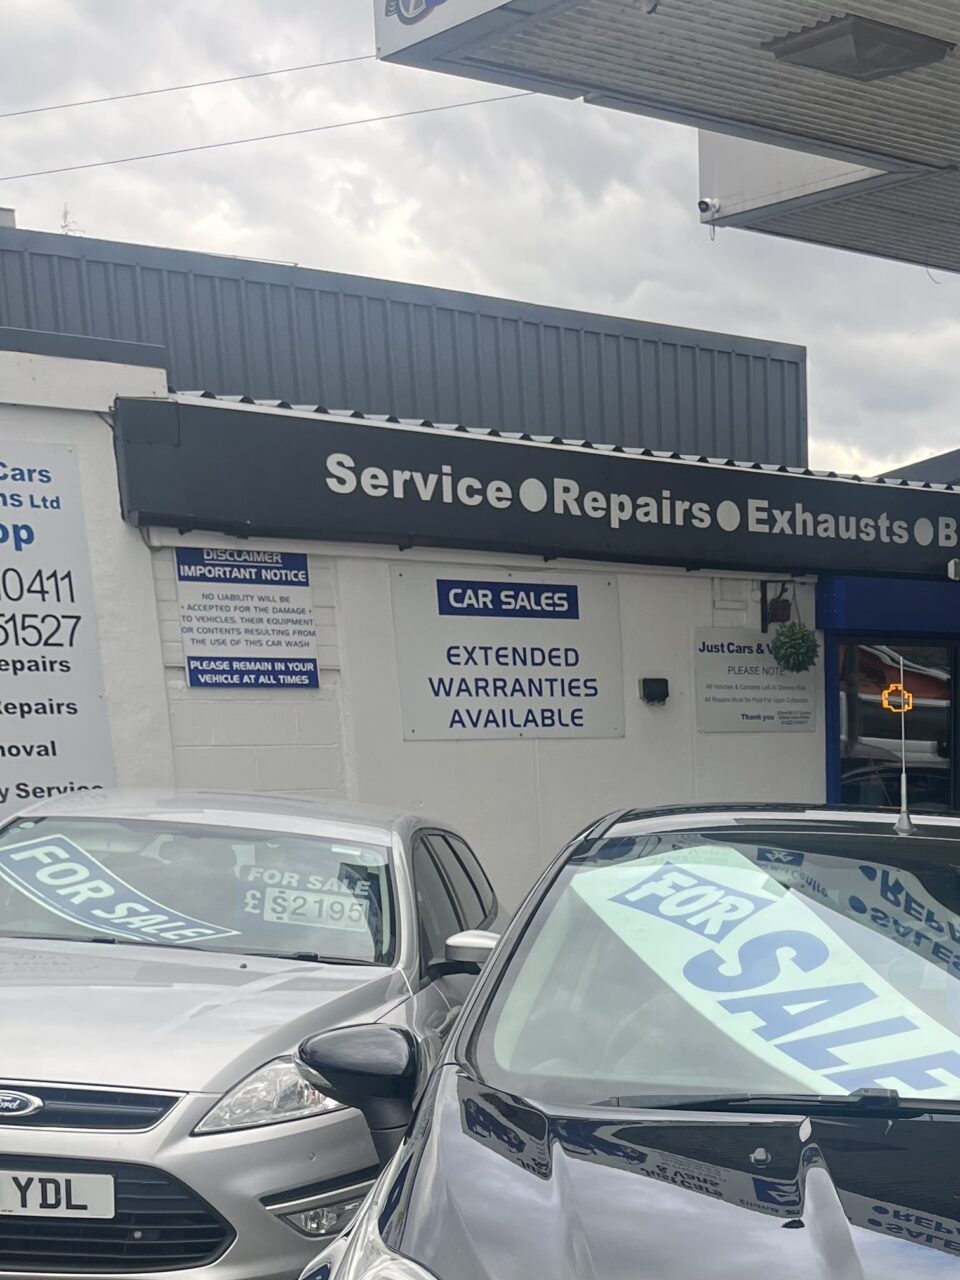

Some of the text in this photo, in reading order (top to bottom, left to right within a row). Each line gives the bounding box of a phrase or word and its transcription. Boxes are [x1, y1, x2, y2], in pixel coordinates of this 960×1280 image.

[29, 494, 61, 509] Ltd
[325, 453, 512, 508] Service
[553, 477, 711, 529] Repairs
[747, 499, 909, 545] Exhausts
[203, 549, 282, 563] DISCLAIMER
[180, 565, 306, 582] IMPORTANT NOTICE
[2, 567, 75, 603] 0411
[448, 588, 568, 612] CAR SALES
[187, 604, 231, 612] ACCEPTED
[234, 605, 250, 613] FOR
[272, 607, 306, 615] DAMAGE
[240, 617, 264, 625] THEIR
[267, 618, 313, 626] EQUIPMENT
[197, 627, 241, 635] CONTENTS
[244, 628, 290, 636] RESULTING
[292, 629, 316, 637] FROM
[191, 638, 206, 646] THE
[244, 639, 263, 647] THIS
[285, 640, 309, 648] WASH
[699, 641, 725, 653] Just
[727, 642, 753, 654] Cars
[756, 643, 764, 654] &
[446, 645, 579, 667] EXTENDED
[190, 660, 314, 671] PLEASE REMAIN IN YOUR
[728, 666, 784, 676] PLEASE NOTE
[198, 674, 309, 684] VEHICLE AT ALL TIMES
[429, 677, 599, 698] WARRANTIES
[0, 699, 78, 719] epairs
[449, 708, 585, 729] AVAILABLE
[0, 741, 57, 757] oval
[248, 867, 371, 896] FOR SALE
[10, 846, 217, 940] FOR SALE
[244, 890, 261, 914] £
[625, 871, 755, 936] FOR
[12, 1176, 88, 1210] YDL
